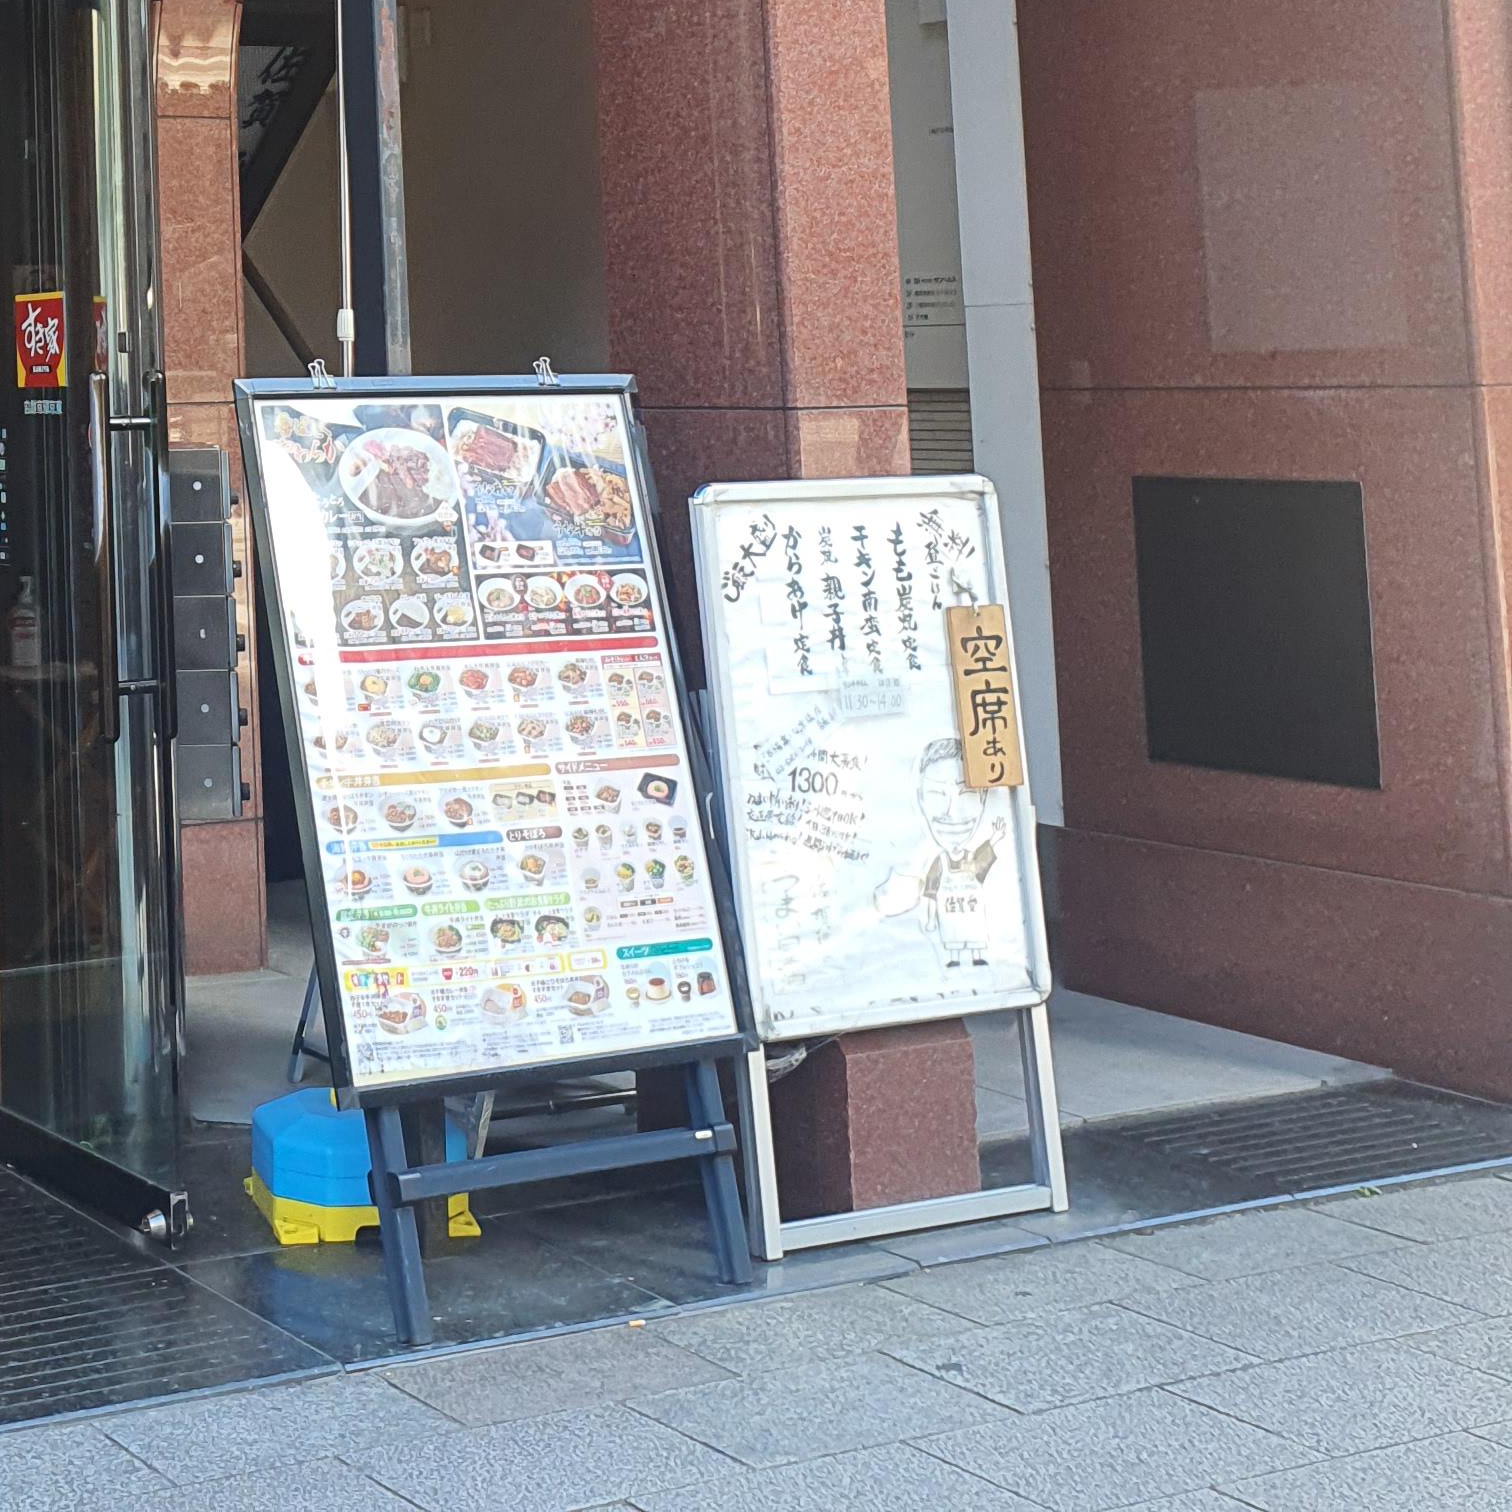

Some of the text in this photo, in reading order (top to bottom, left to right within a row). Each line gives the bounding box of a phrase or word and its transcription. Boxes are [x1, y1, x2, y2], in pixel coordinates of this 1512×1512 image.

[21, 303, 60, 362] すき家
[960, 625, 1009, 784] 空席あり
